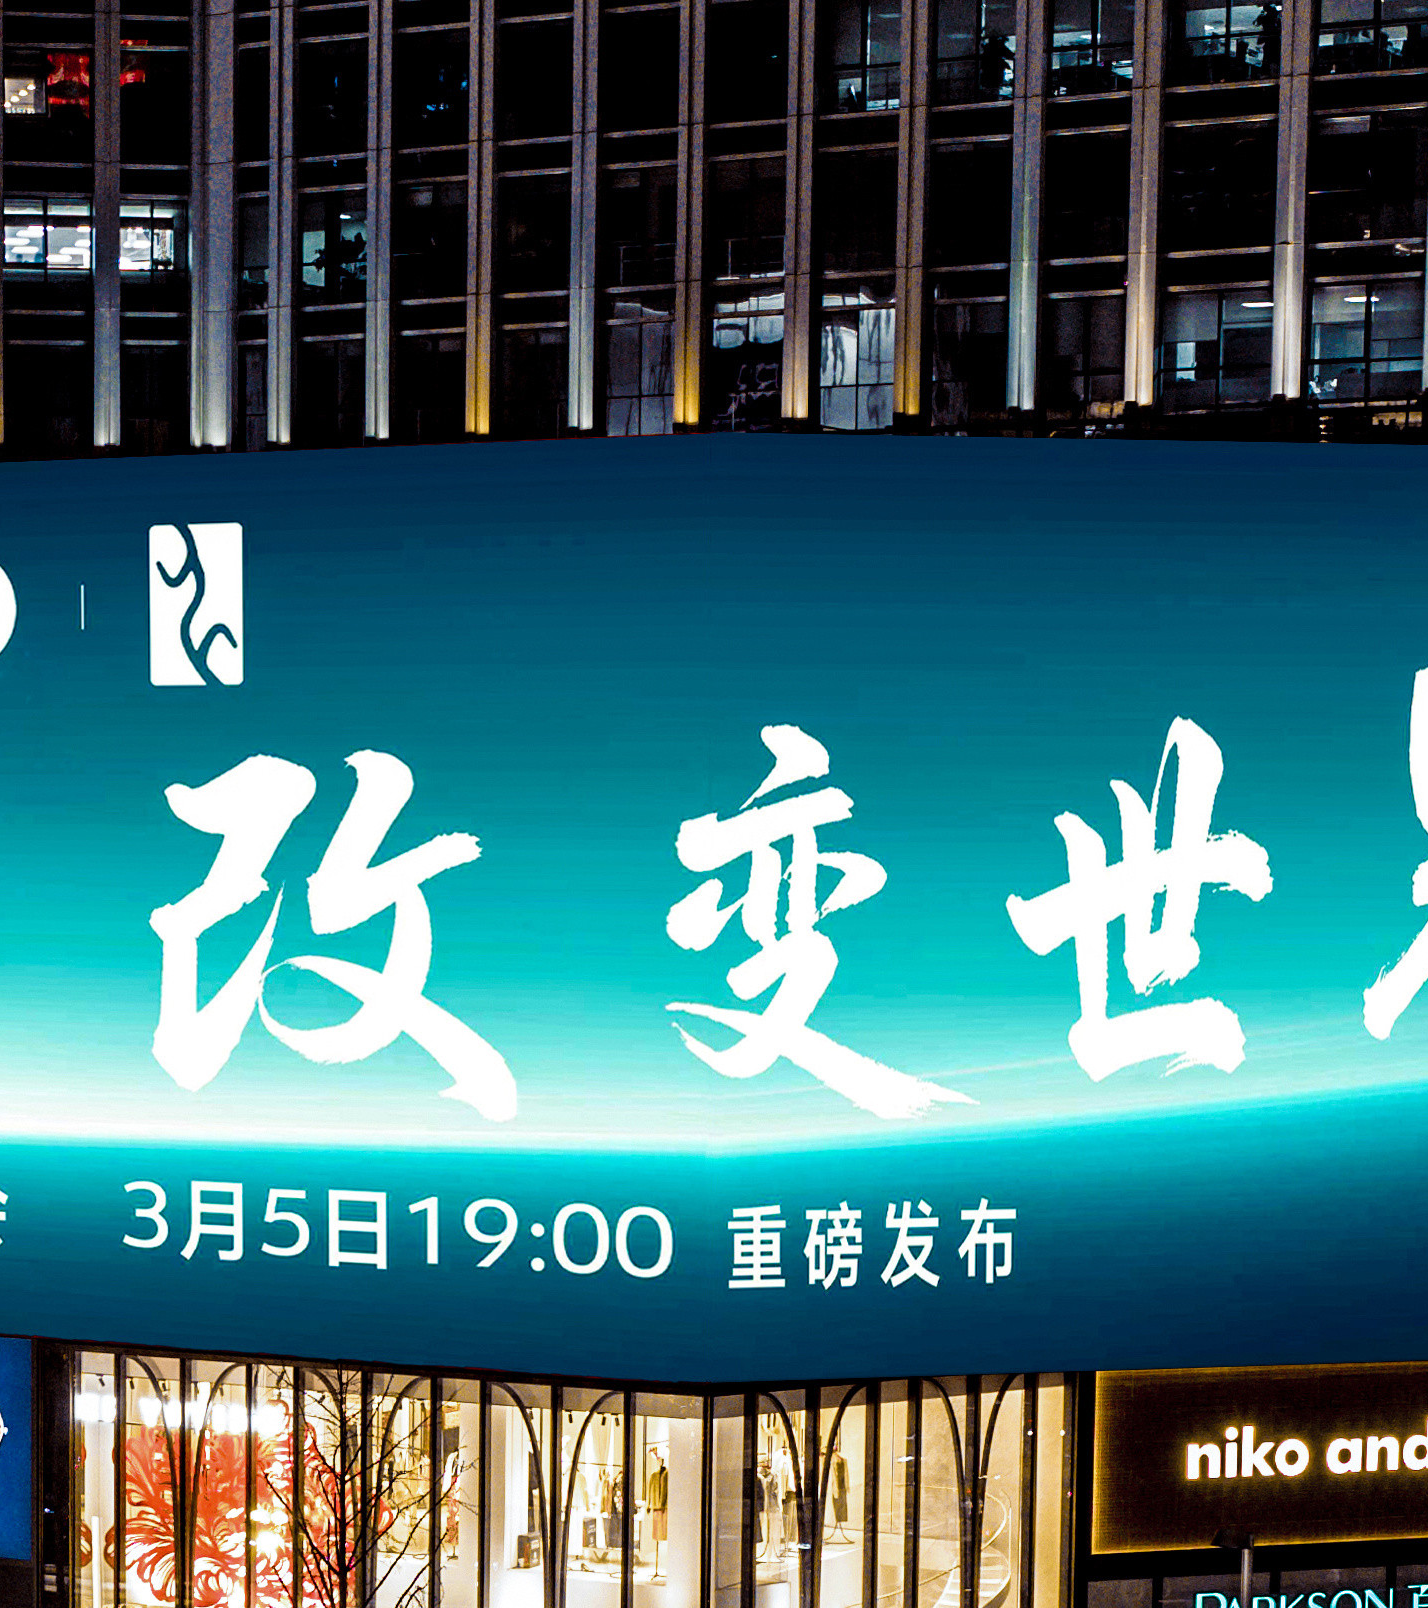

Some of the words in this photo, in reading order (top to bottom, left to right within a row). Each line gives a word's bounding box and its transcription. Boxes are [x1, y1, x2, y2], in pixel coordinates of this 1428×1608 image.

[122, 1180, 673, 1278] 3月5日19:00
[727, 1198, 1018, 1290] 重磅发布
[1187, 1425, 1310, 1480] niko
